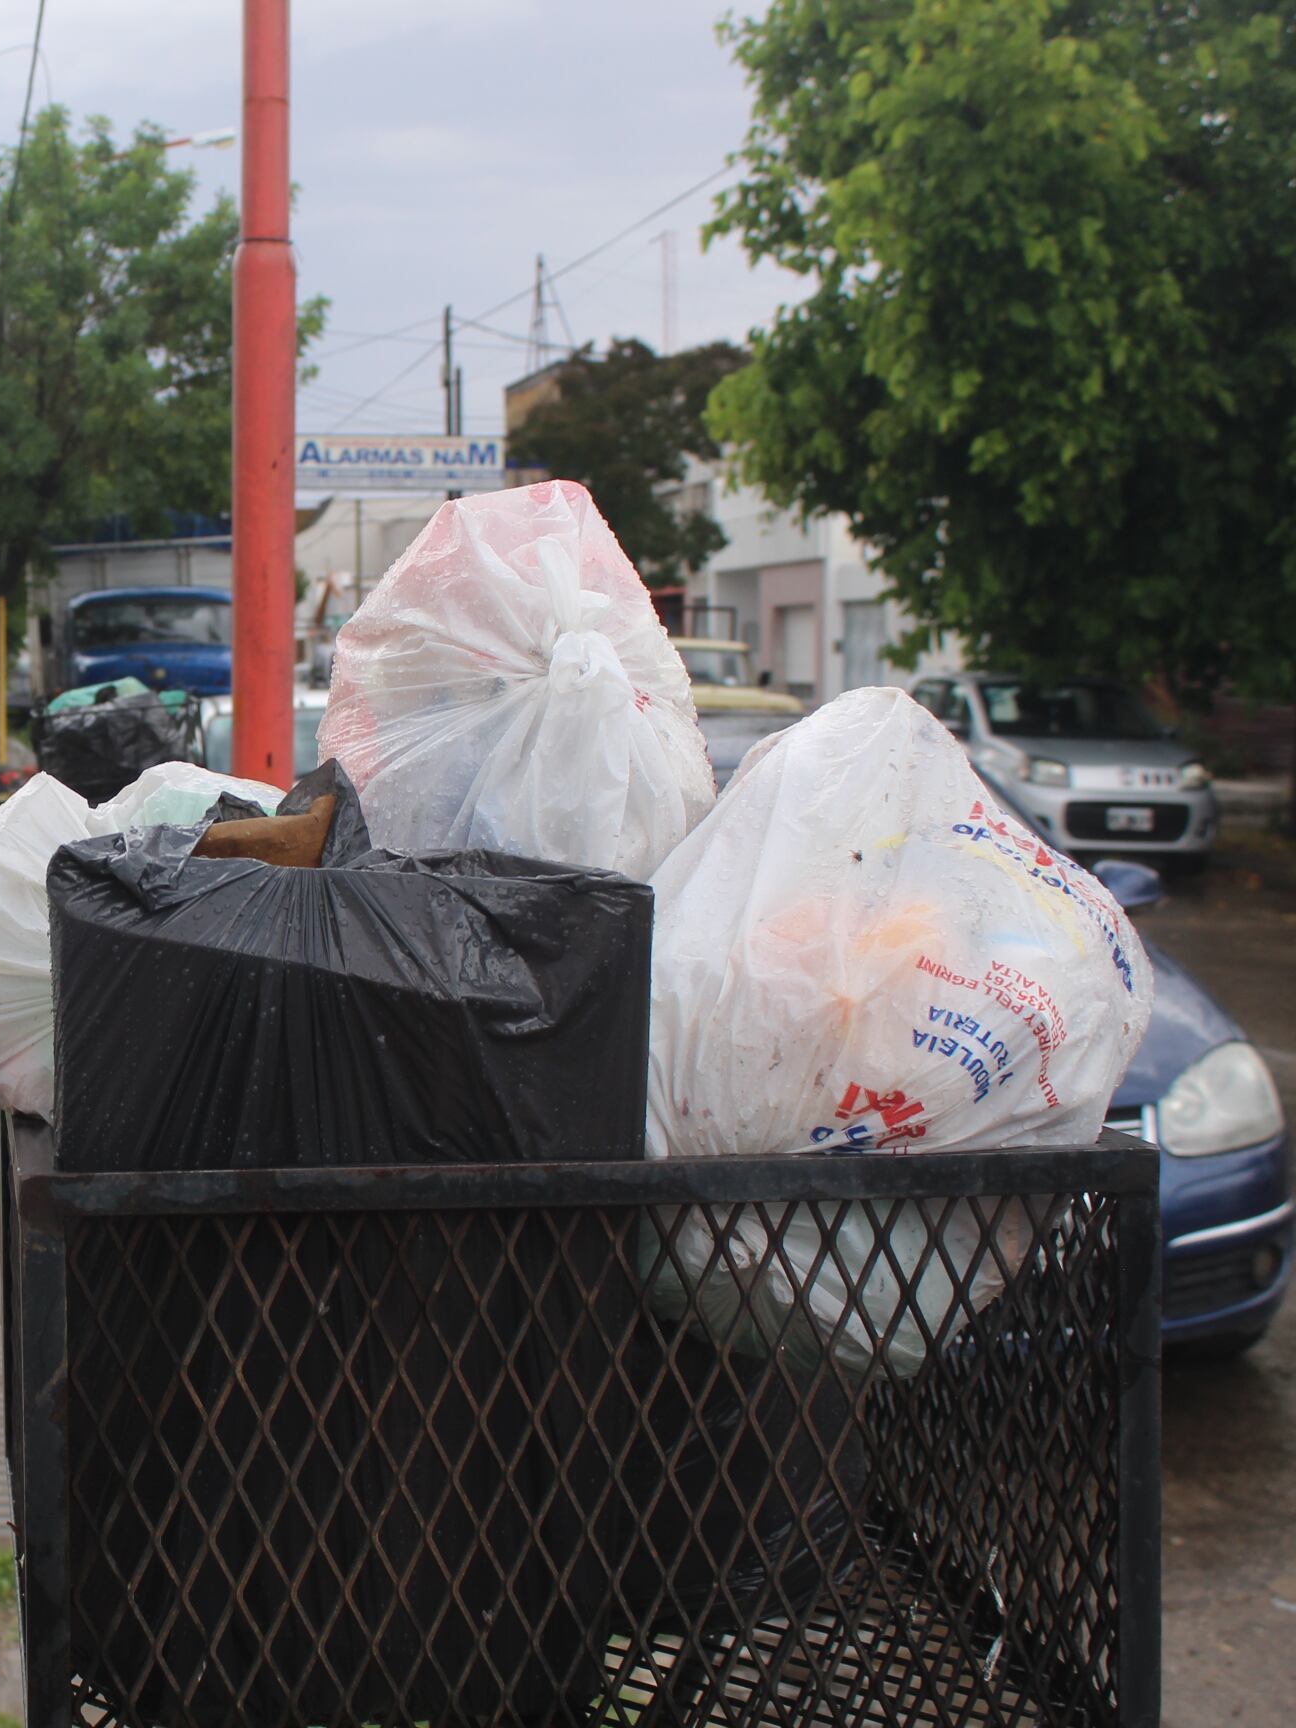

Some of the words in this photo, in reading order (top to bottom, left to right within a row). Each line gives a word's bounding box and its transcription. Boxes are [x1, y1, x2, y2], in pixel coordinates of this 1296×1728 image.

[984, 971, 1046, 1012] 435-761
[991, 960, 1035, 989] ALTA
[929, 1005, 1010, 1071] RUTERIA
[1038, 985, 1067, 1042] PUNTA
